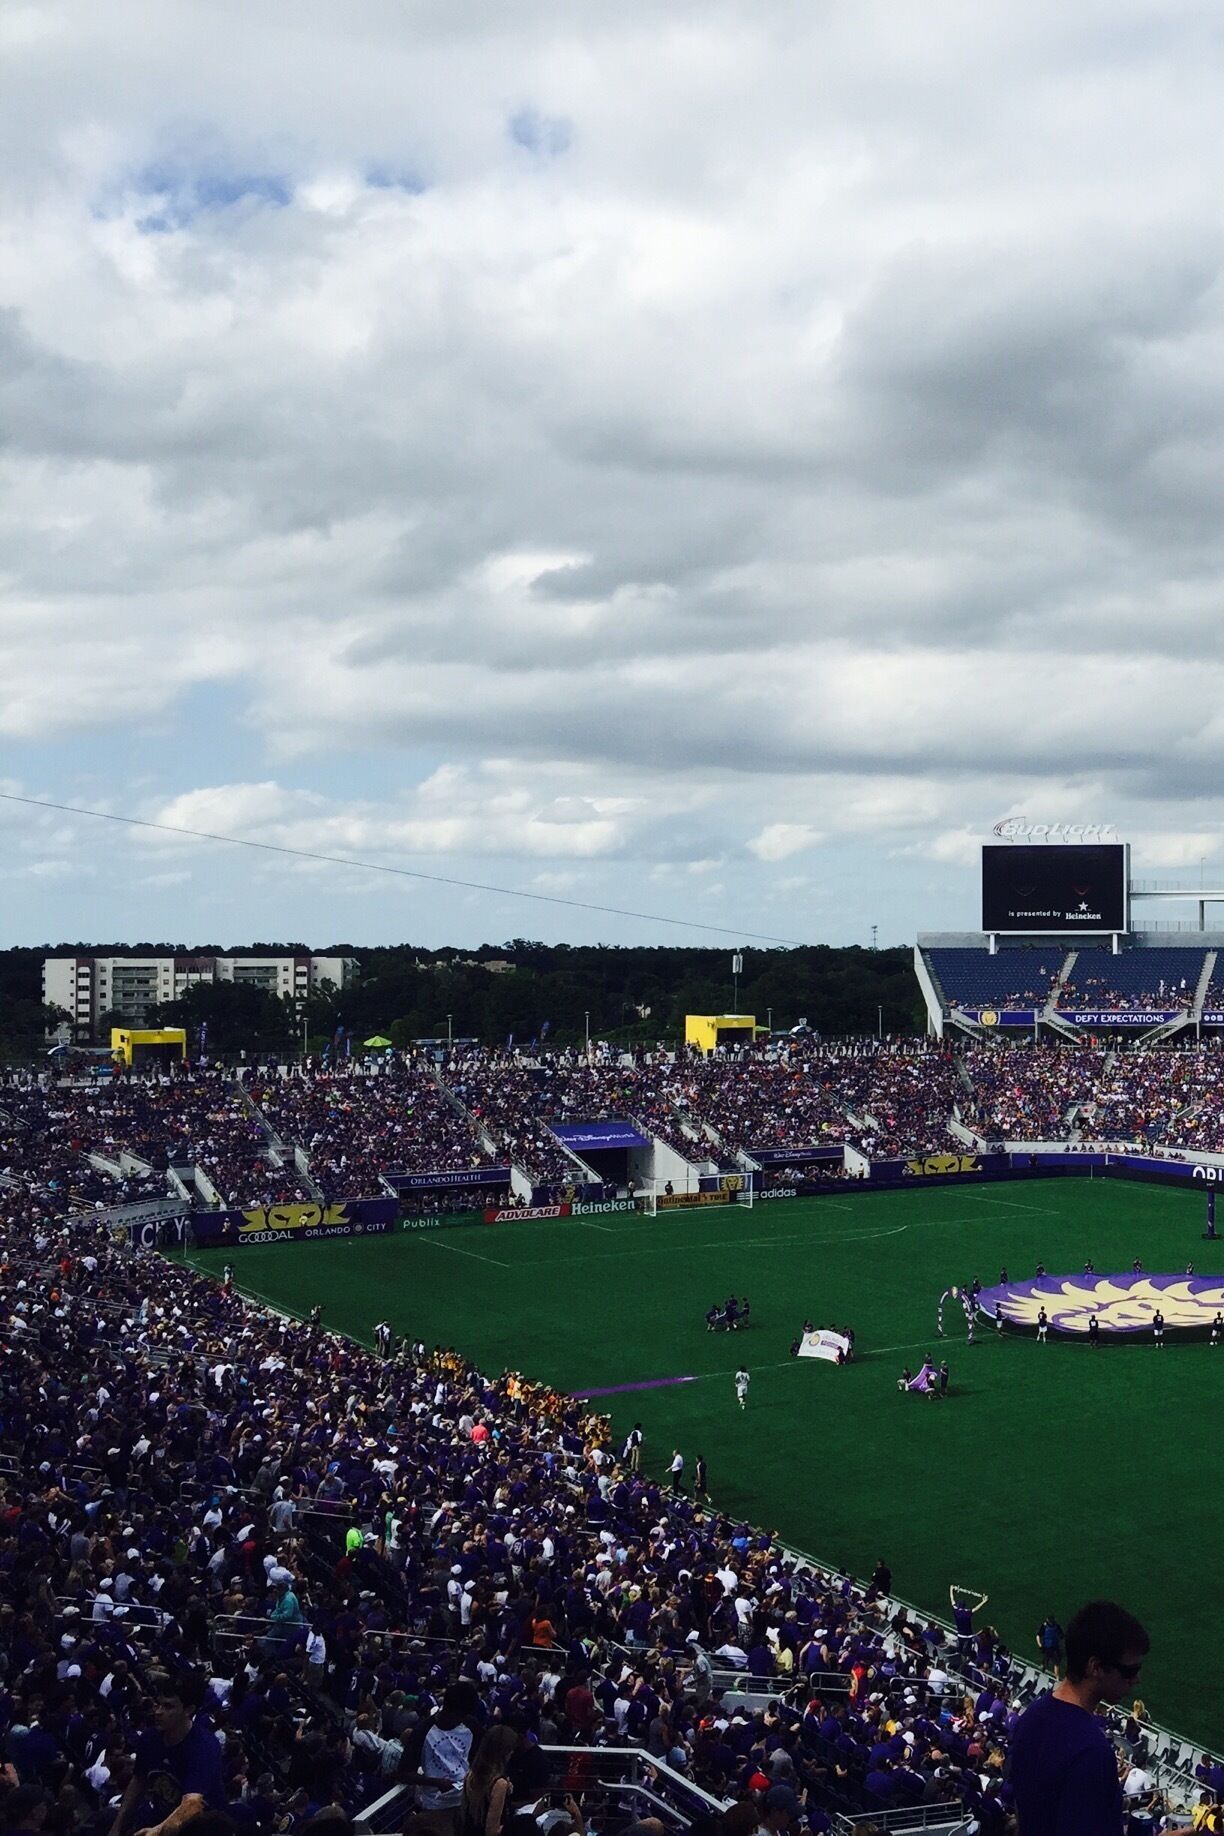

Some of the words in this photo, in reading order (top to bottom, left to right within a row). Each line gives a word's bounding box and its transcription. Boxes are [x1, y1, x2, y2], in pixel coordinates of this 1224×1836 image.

[1065, 912, 1102, 920] Heineken
[1075, 1013, 1099, 1023] DEFY
[1100, 1013, 1165, 1023] EXPECTATIONS
[760, 1188, 797, 1199] adidas
[572, 1200, 636, 1215] Heineken
[495, 1206, 562, 1222] ADVOCARE
[403, 1217, 441, 1229] Publix
[305, 1225, 351, 1237] ORLANDO
[366, 1223, 387, 1232] CITY
